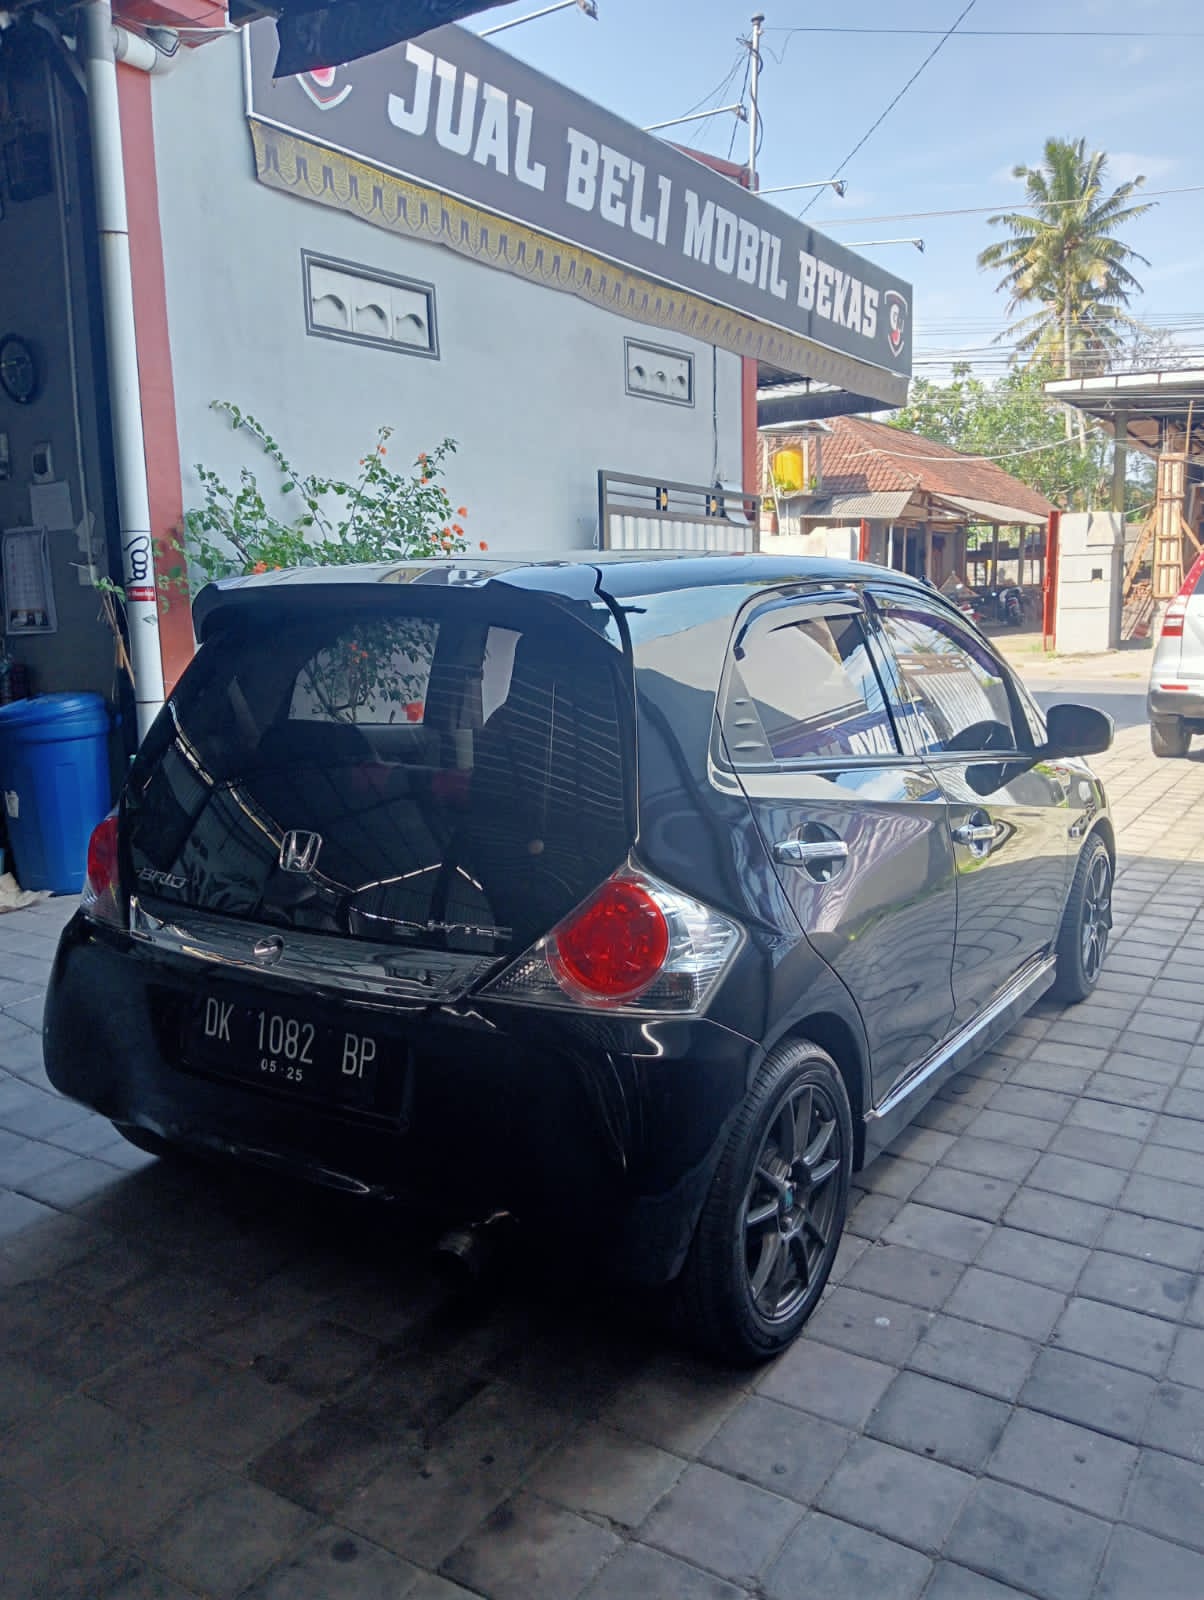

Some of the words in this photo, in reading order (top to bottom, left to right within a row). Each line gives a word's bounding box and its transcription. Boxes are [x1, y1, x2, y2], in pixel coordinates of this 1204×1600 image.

[388, 42, 546, 191] JUAL
[566, 127, 672, 246] BELI
[682, 188, 788, 300] MOBIL
[797, 250, 880, 339] BEKAS
[204, 997, 234, 1041] DK
[258, 1011, 315, 1064] 1082
[342, 1033, 376, 1079] BP
